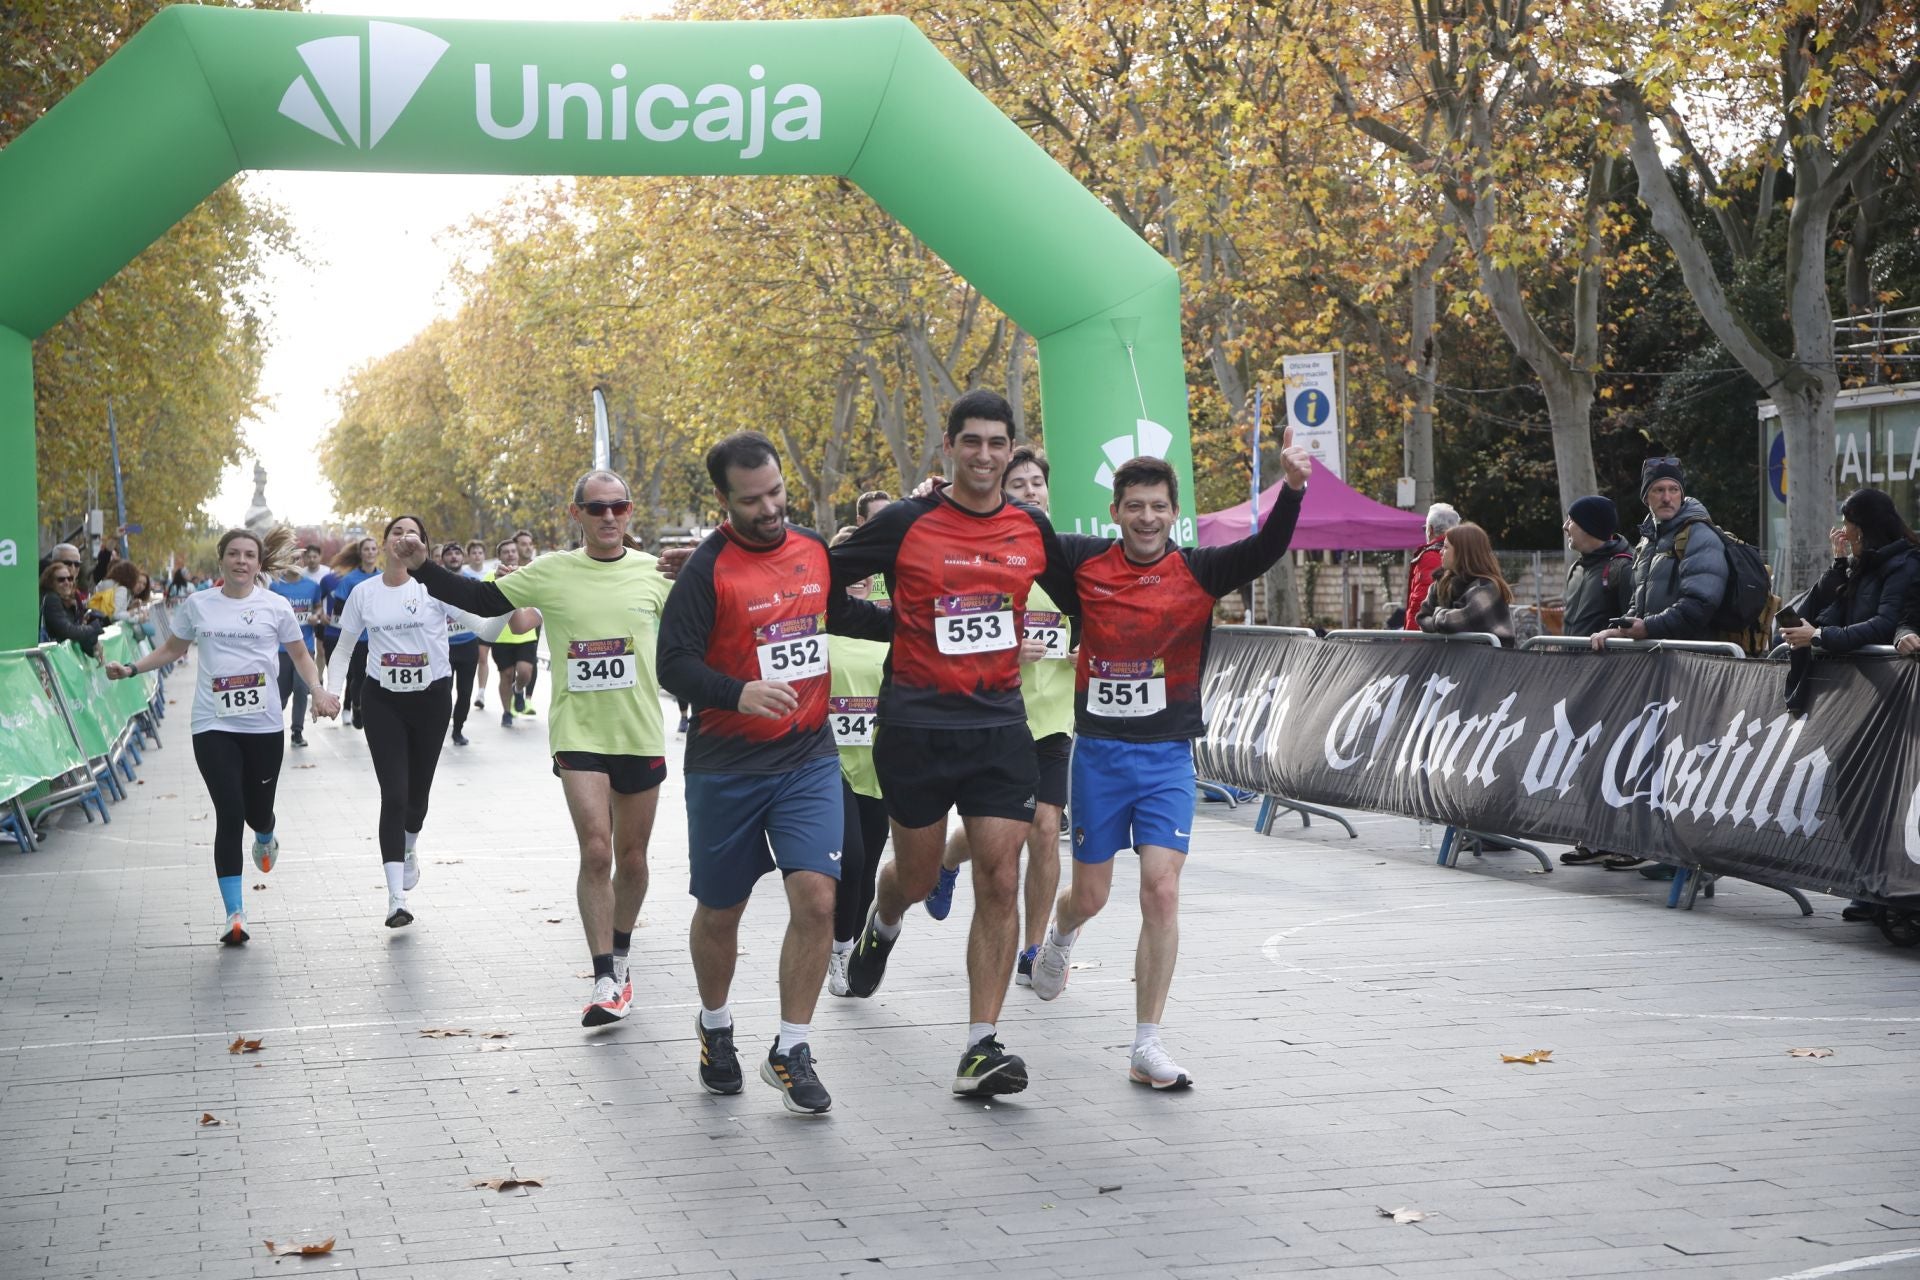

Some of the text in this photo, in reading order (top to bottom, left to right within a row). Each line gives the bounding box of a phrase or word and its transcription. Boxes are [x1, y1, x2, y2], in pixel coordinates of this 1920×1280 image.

[475, 63, 822, 158] Unicaja
[1007, 556, 1027, 566] 2020
[801, 584, 821, 595] 2020
[1139, 576, 1160, 585] 2020
[948, 615, 1002, 643] 553
[771, 639, 821, 671] 552
[388, 668, 423, 684] 181
[576, 659, 626, 681] 340
[221, 690, 260, 708] 183
[1098, 682, 1149, 705] 551
[1325, 674, 1410, 770] El
[1395, 673, 1527, 788] Norte
[1521, 698, 1603, 799] de
[1601, 696, 1832, 840] Castilla
